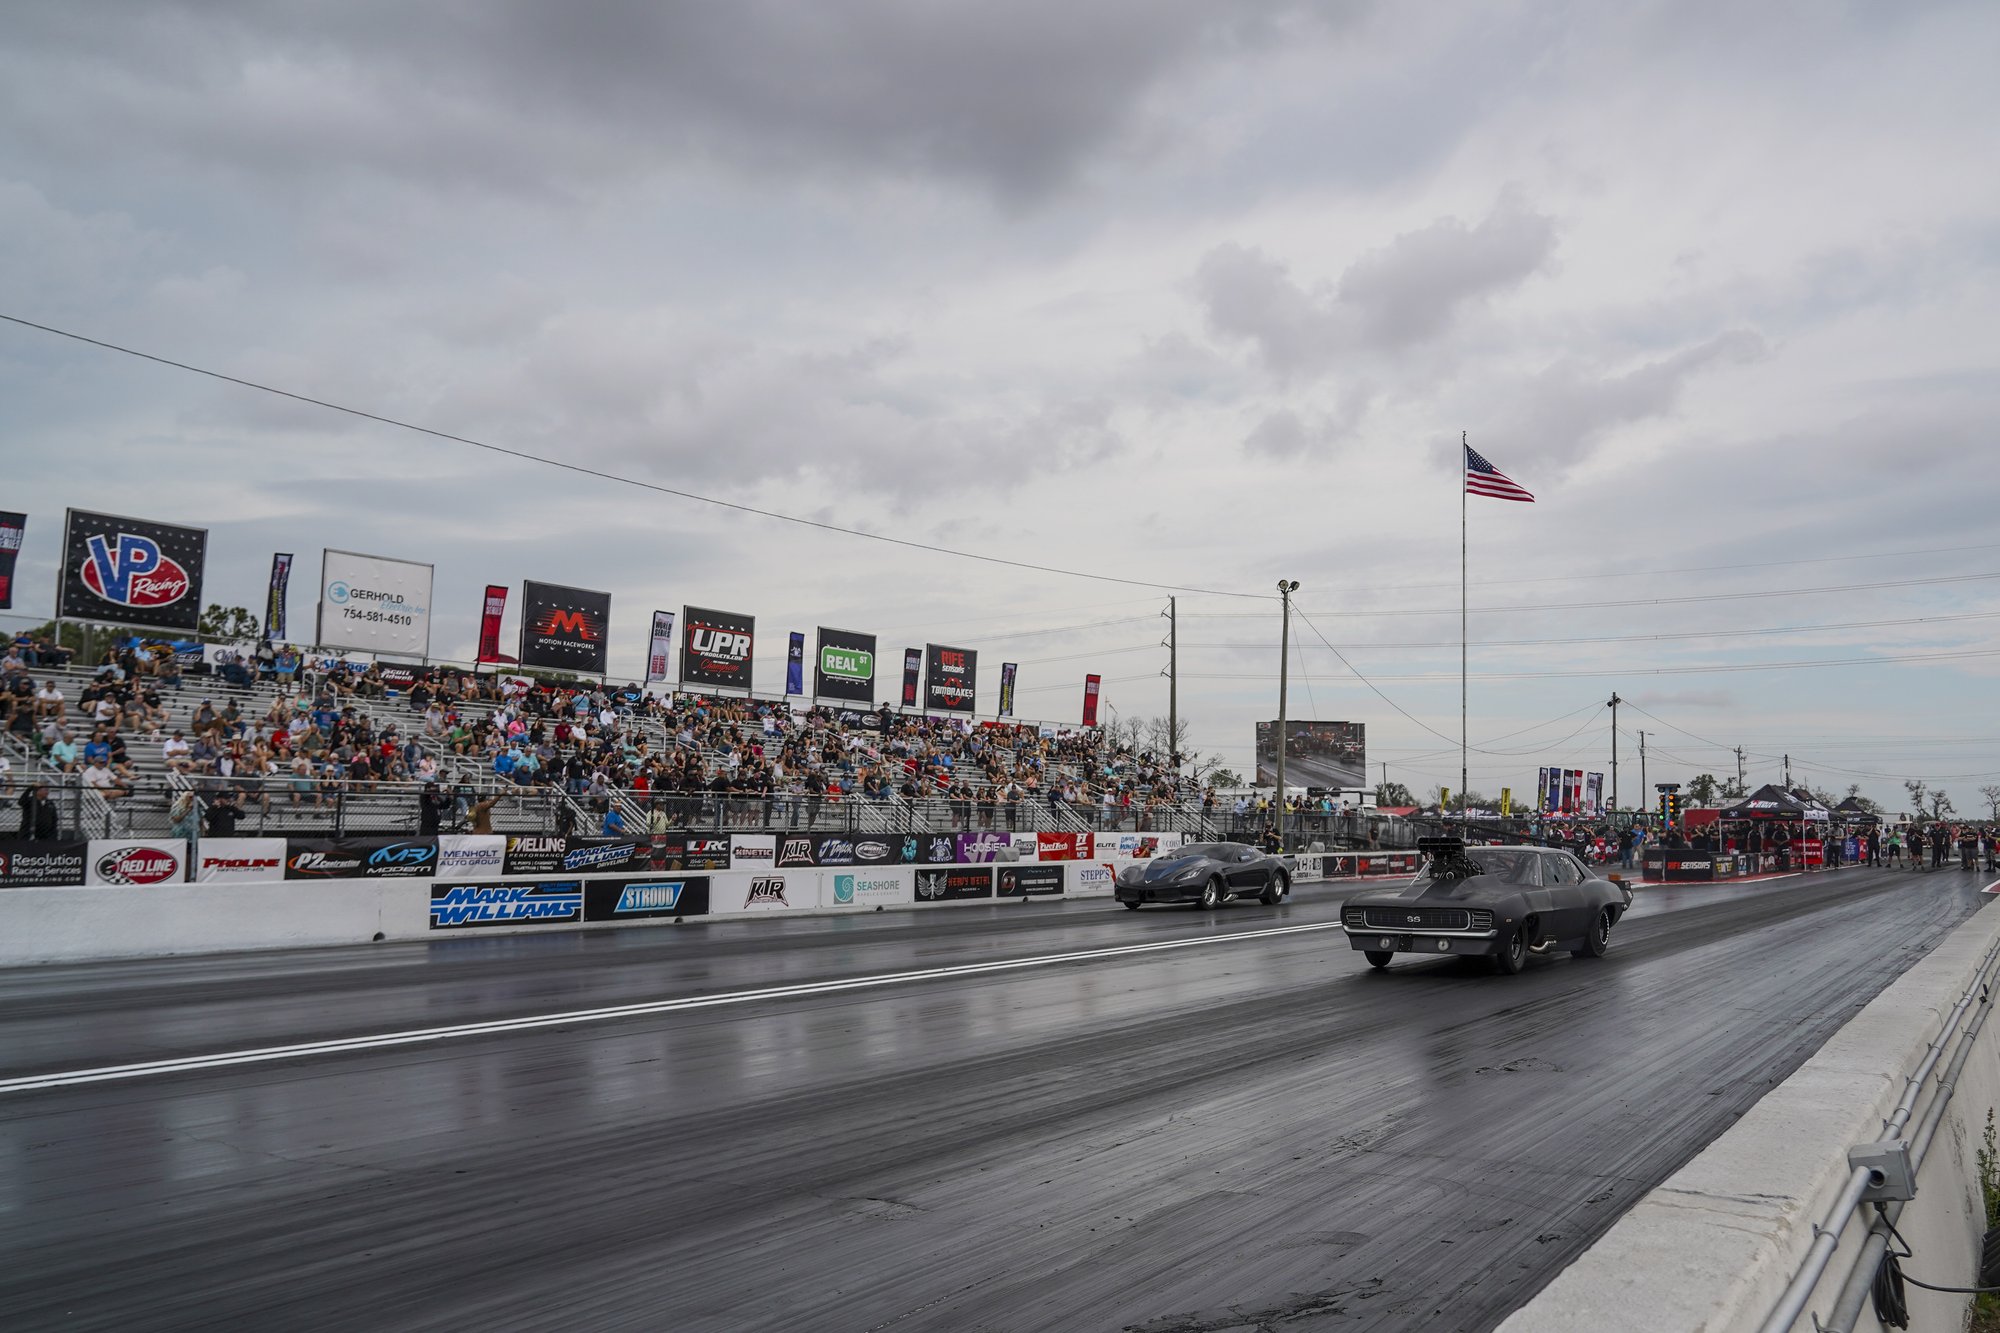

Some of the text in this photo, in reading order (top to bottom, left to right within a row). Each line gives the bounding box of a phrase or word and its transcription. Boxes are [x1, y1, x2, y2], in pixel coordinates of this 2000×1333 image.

[86, 533, 161, 604] VP
[131, 577, 187, 598] Racing
[350, 588, 404, 604] GERHOLD
[343, 608, 412, 626] 754-581-4510
[655, 621, 672, 630] WORLD
[654, 629, 671, 638] SERIES
[538, 638, 595, 649] MOTION RACEWORKS
[692, 629, 751, 657] UPR
[826, 654, 868, 672] REAL ST
[511, 837, 566, 852] MELLING
[929, 837, 952, 850] J&A
[12, 853, 82, 866] Resolution
[443, 850, 498, 858] MENHOLT
[564, 849, 634, 870] WILLIAMS
[735, 848, 773, 856] KINETIC
[121, 858, 174, 873] RED LINE
[294, 852, 326, 869] P2
[12, 866, 82, 877] Racing Services
[1080, 869, 1110, 881] STEPP'S
[856, 880, 900, 891] SEASHORE
[625, 886, 674, 908] STROUD
[436, 901, 576, 925] WILLIAMS
[1406, 915, 1421, 923] SS
